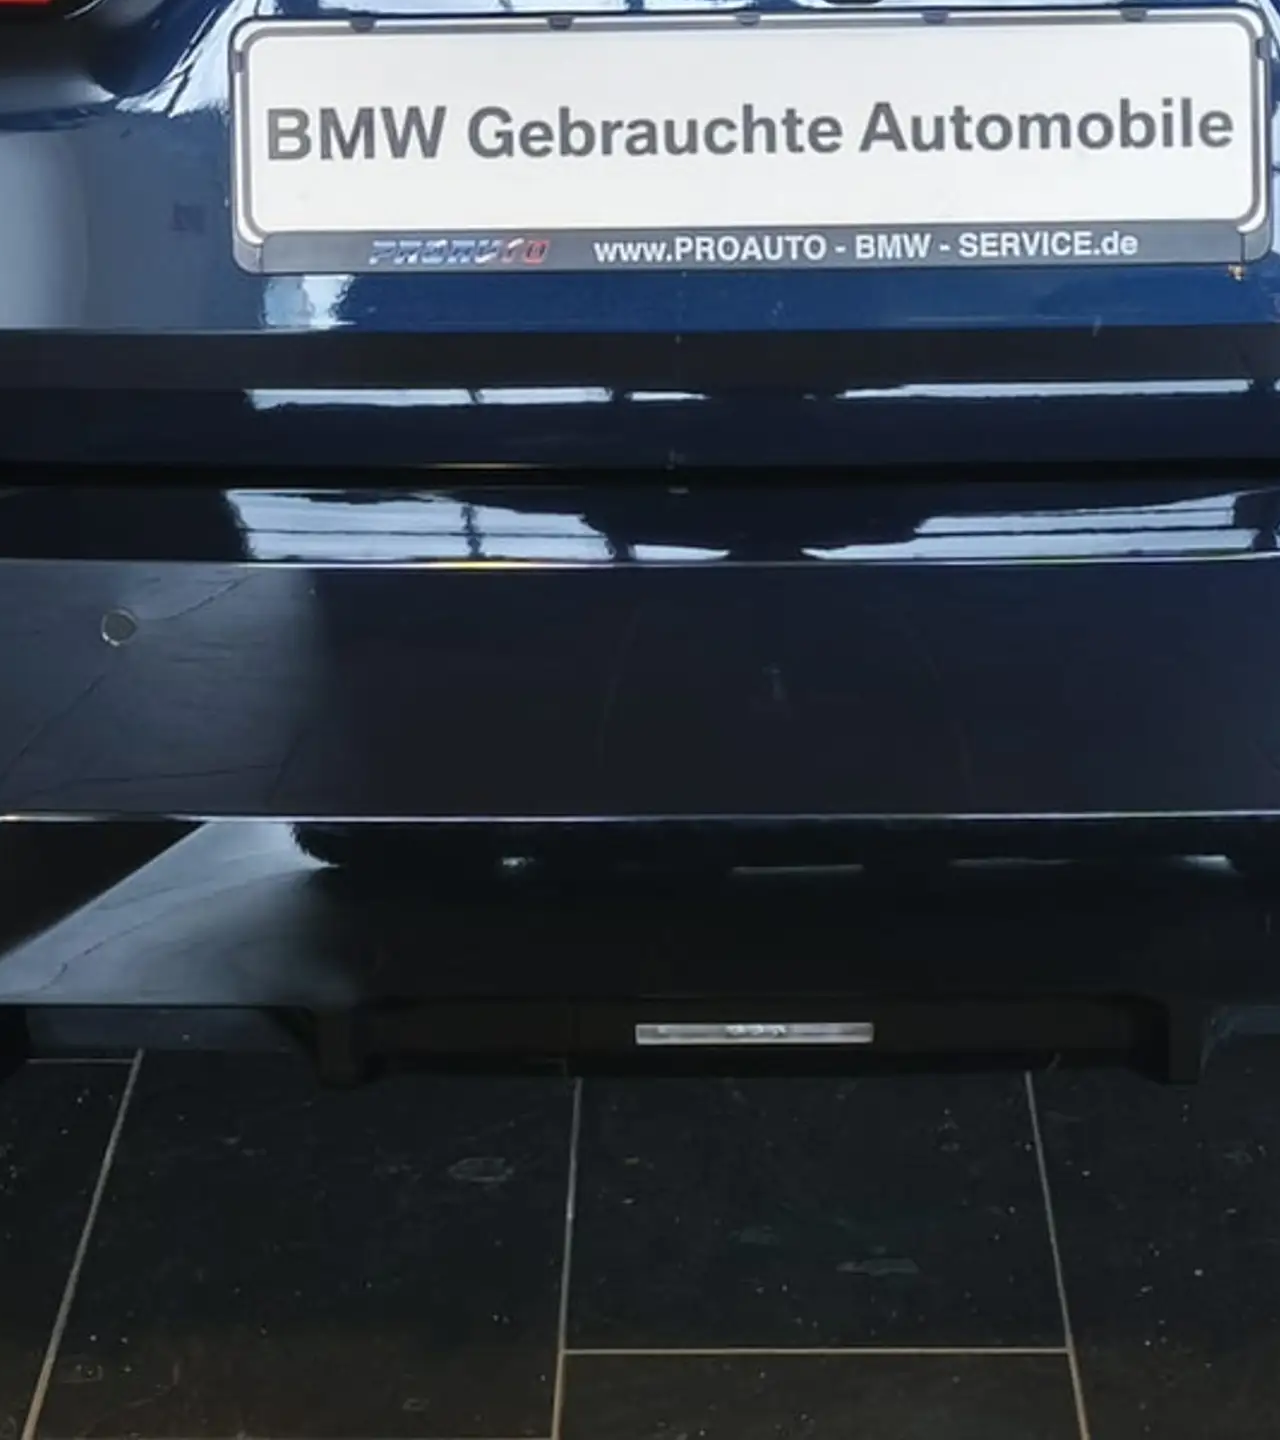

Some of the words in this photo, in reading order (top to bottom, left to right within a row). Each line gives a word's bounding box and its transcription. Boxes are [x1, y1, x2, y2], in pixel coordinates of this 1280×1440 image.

[266, 105, 447, 160] BMW
[467, 103, 842, 159] Gebrauchte
[858, 97, 1234, 152] Automobile
[593, 233, 826, 263] www.PROAUTO
[855, 234, 931, 260] BMW
[958, 230, 1138, 257] SERVICE.de
